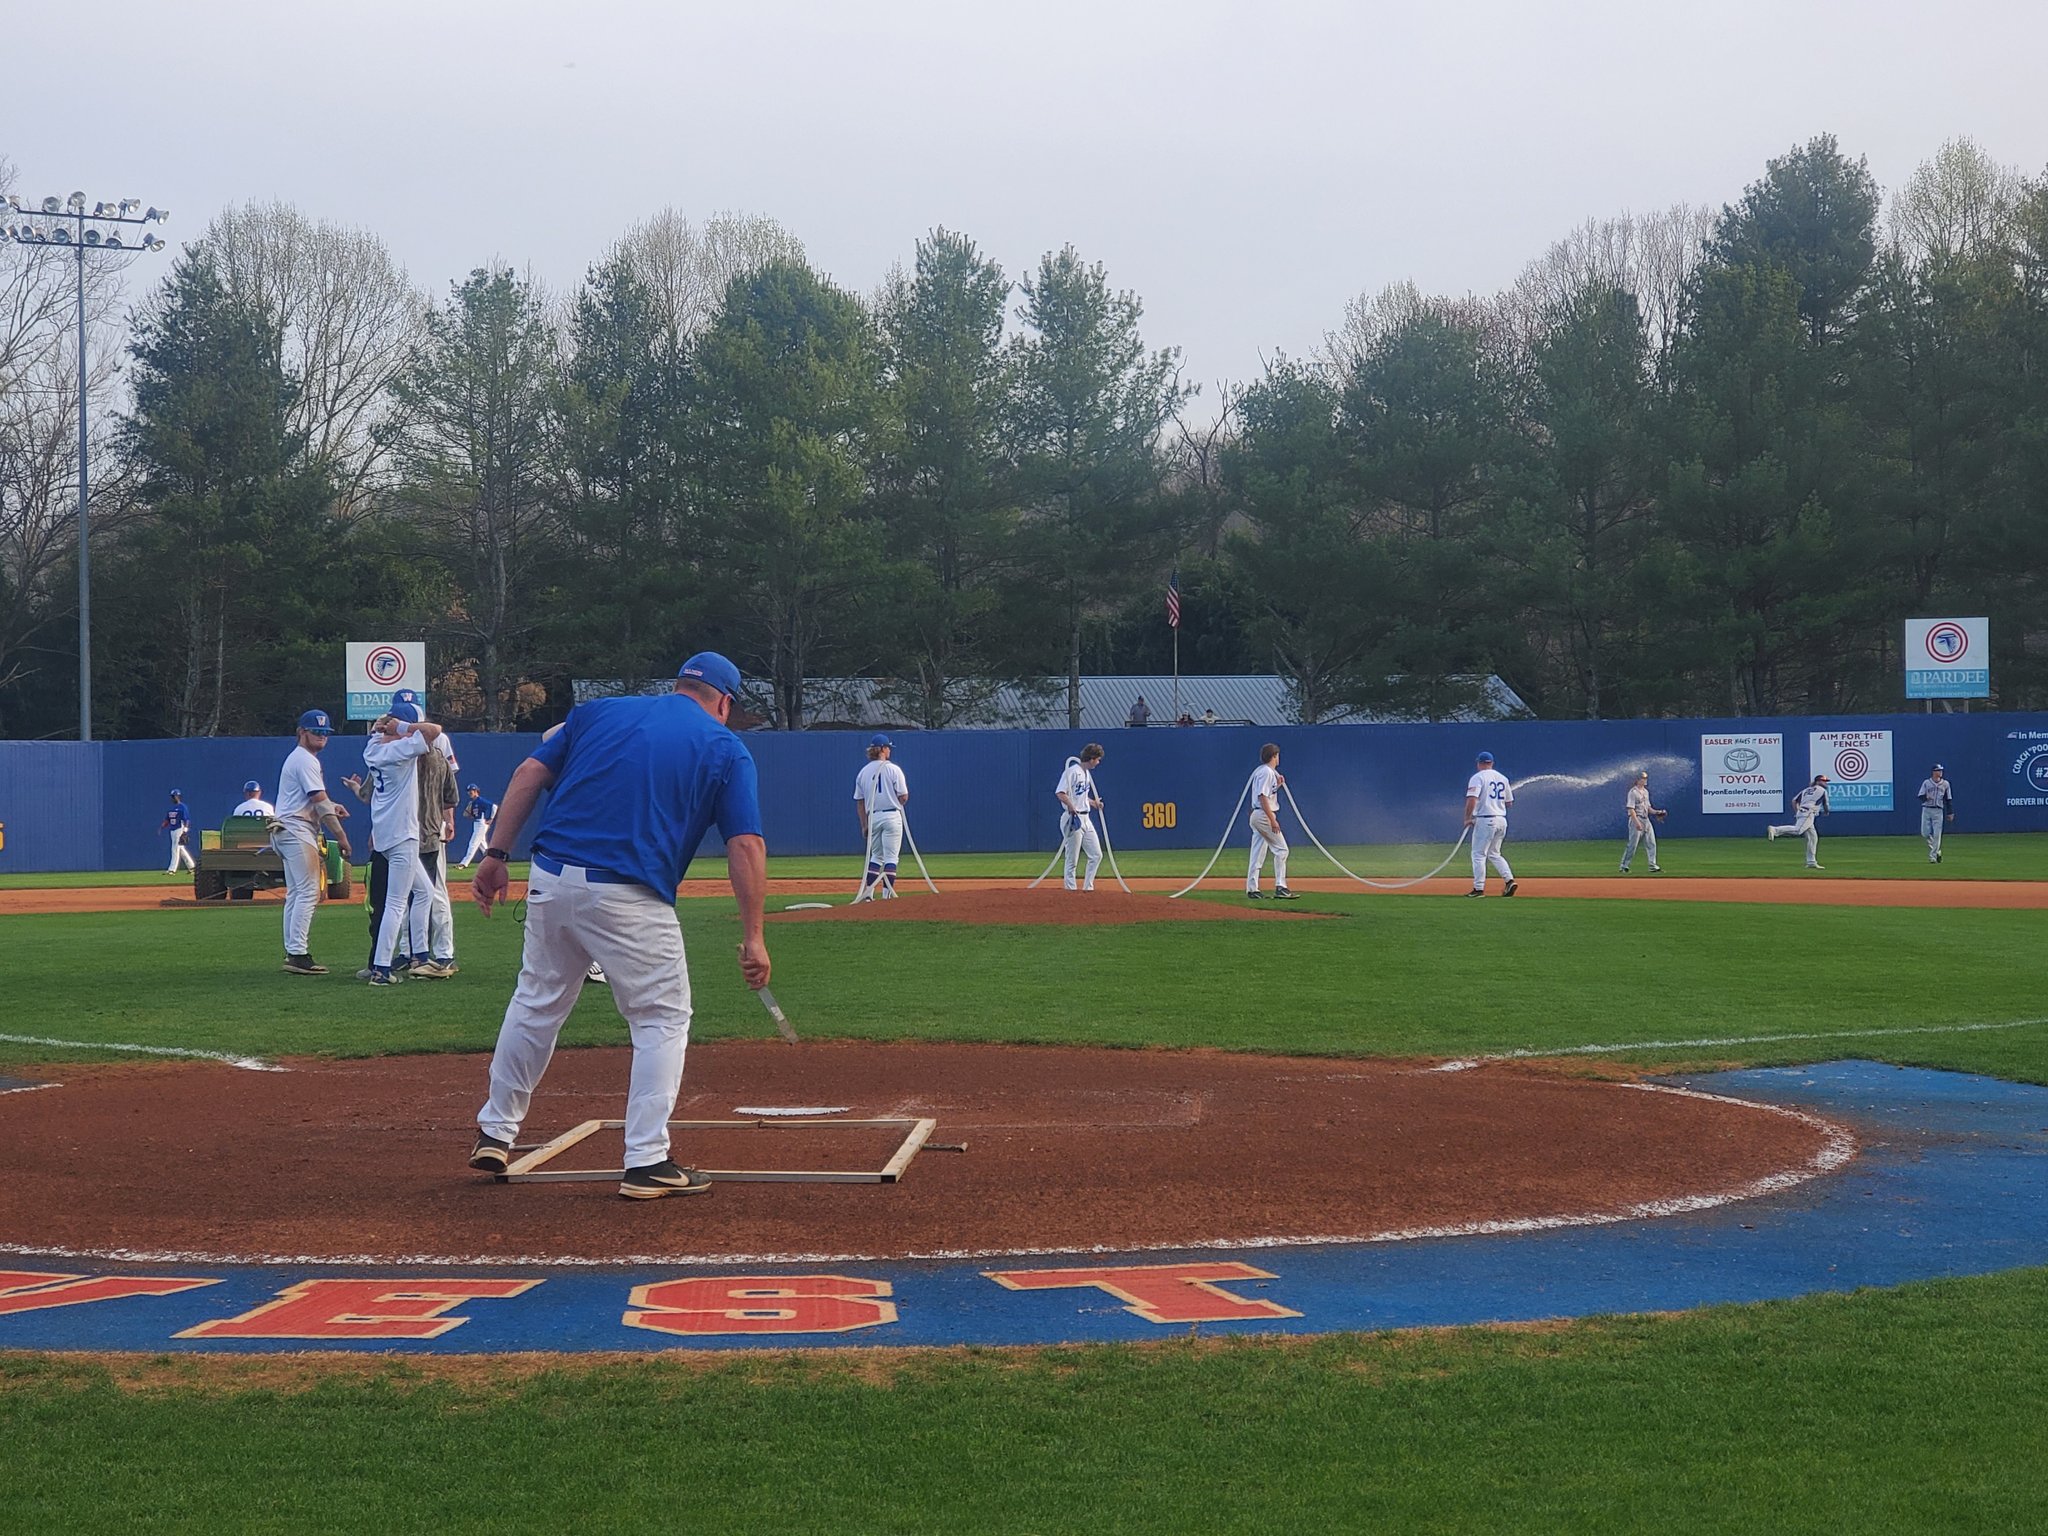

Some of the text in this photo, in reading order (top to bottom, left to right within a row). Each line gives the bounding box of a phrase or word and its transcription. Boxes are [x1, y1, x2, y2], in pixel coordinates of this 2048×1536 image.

[1922, 670, 1986, 684] PARDEE
[363, 693, 423, 706] PARE
[315, 715, 326, 726] W
[1819, 733, 1839, 741] AIM
[1863, 732, 1884, 740] THE
[2018, 731, 2028, 740] In
[1704, 738, 1733, 746] EASLER
[1758, 737, 1781, 745] EASY!
[1833, 740, 1870, 748] FENCES
[2012, 750, 2031, 774] COACH
[1719, 775, 1766, 784] TOYOTA
[1489, 781, 1505, 800] 32
[1703, 788, 1783, 796] BryanEaslerToyota.com
[1828, 784, 1890, 797] PARDEE
[2006, 797, 2036, 806] FOREVER
[2036, 797, 2045, 806] IN
[1142, 802, 1177, 829] 360
